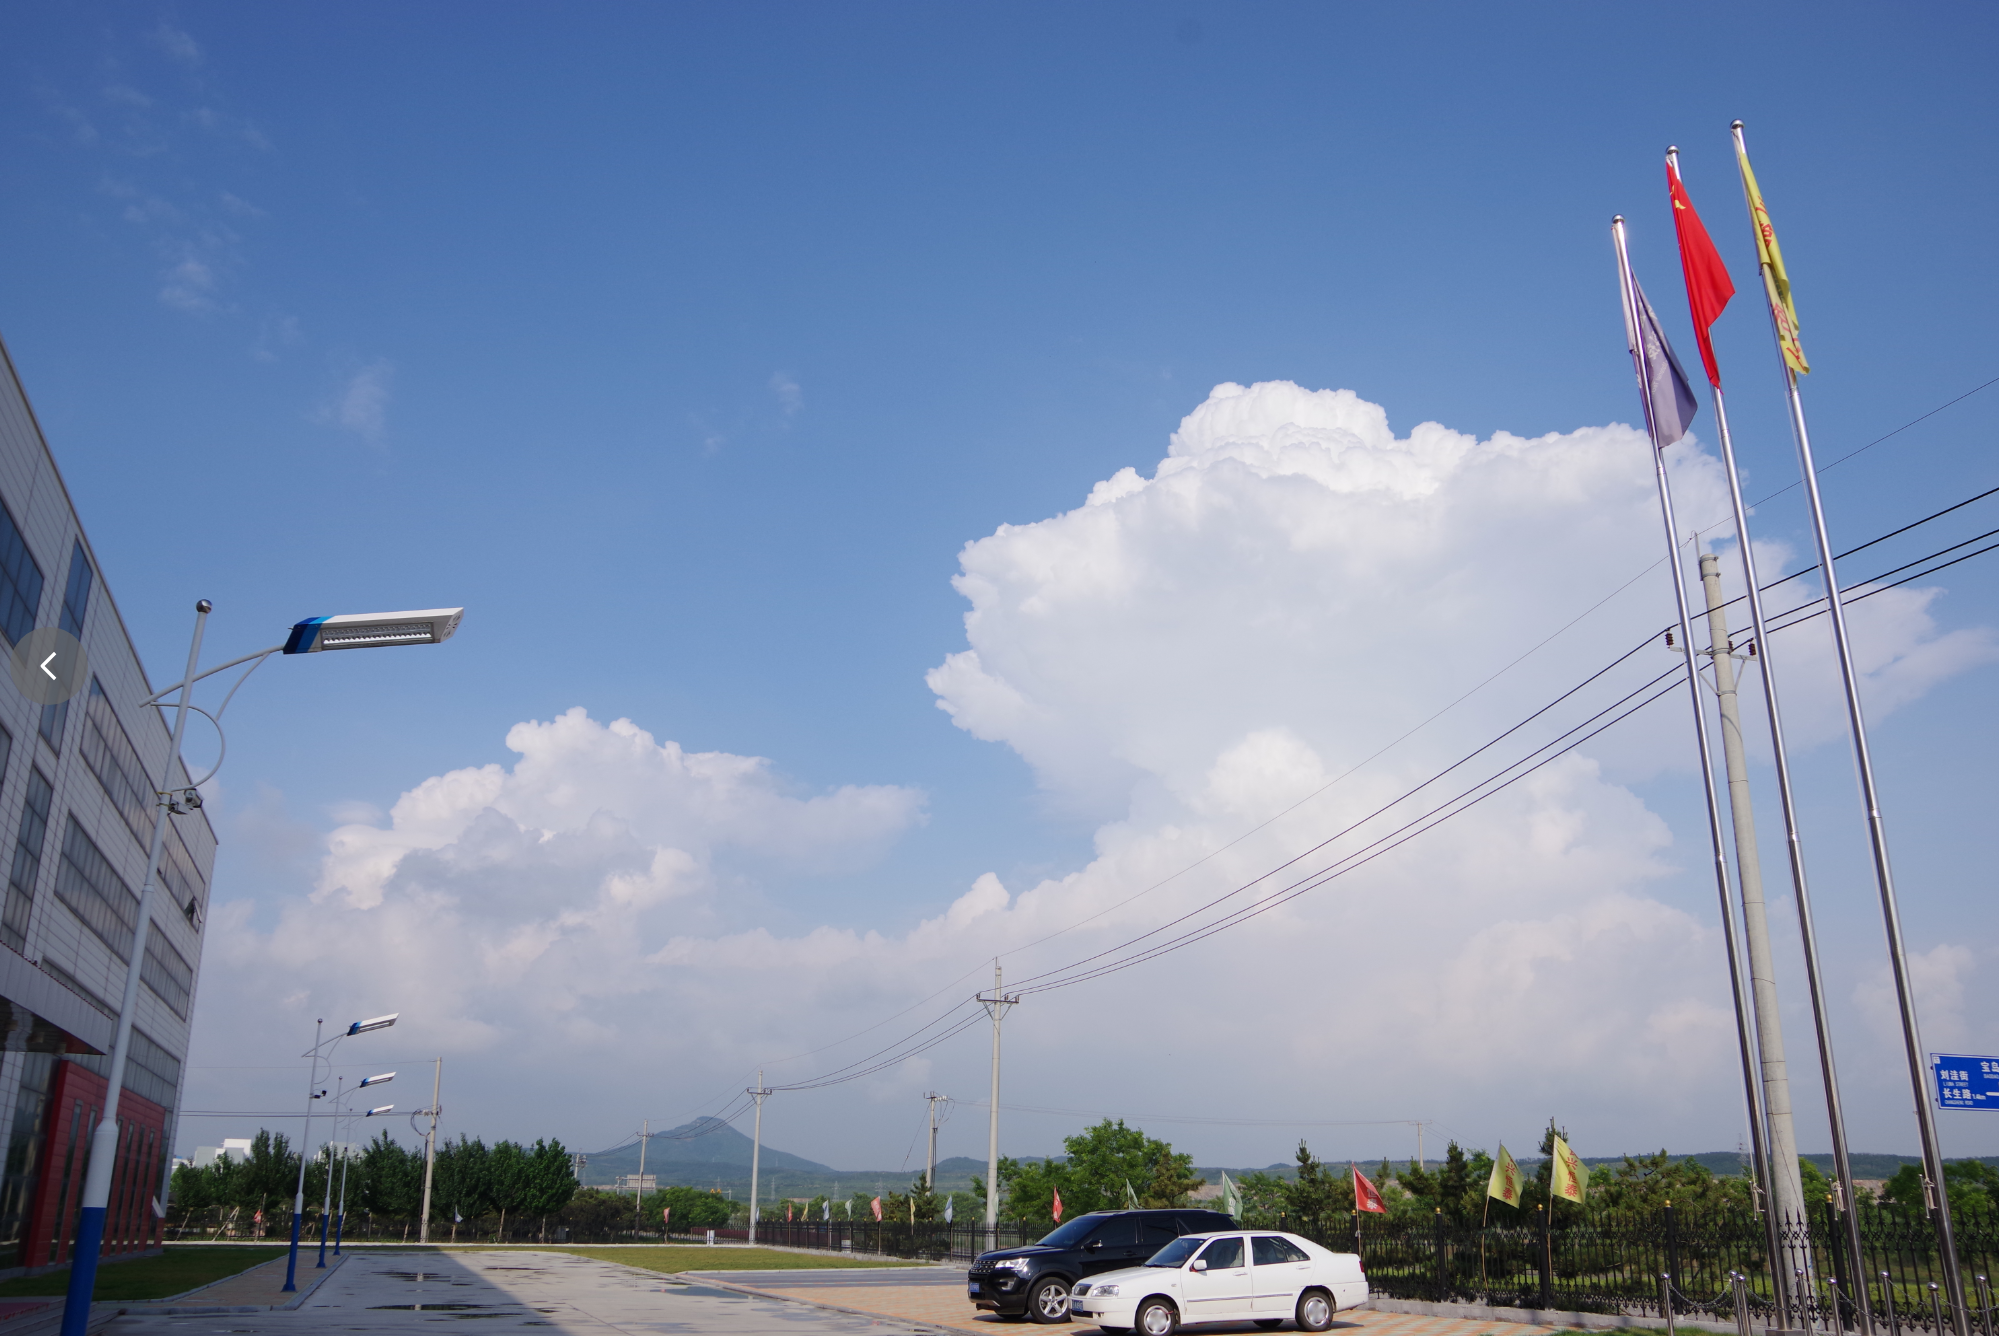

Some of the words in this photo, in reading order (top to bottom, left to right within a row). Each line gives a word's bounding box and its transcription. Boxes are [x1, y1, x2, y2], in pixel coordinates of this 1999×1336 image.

[1942, 1088, 1971, 1099] 长生路
[1502, 1156, 1516, 1200] 兴恒泰
